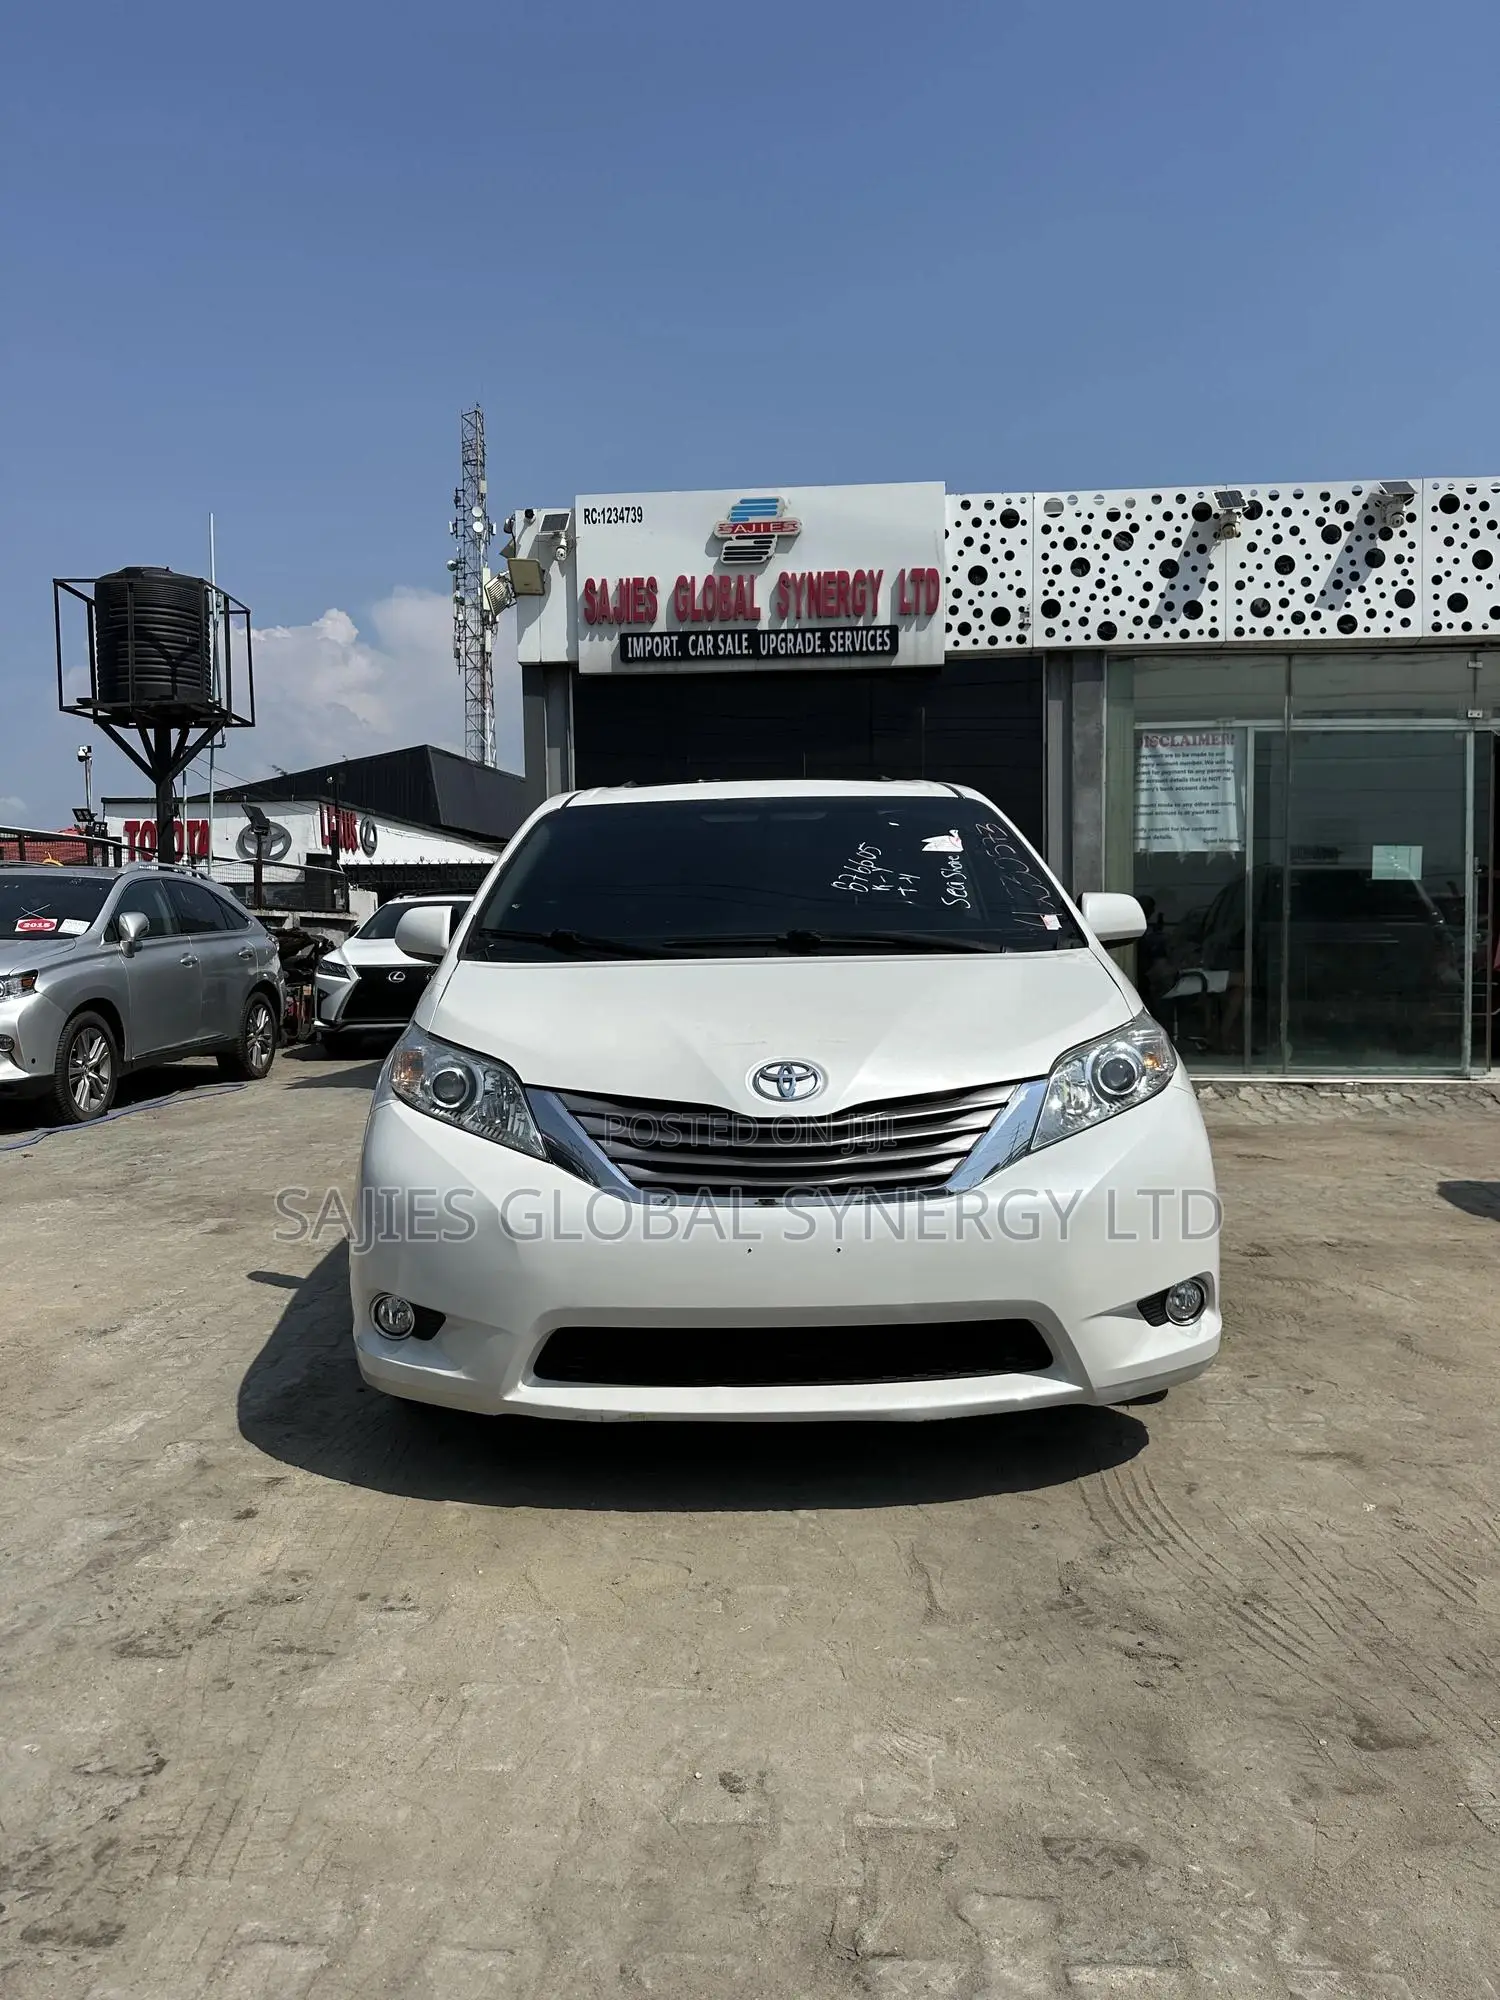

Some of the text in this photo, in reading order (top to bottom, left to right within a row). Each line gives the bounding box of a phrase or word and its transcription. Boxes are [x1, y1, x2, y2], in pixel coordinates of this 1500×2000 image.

[584, 506, 643, 525] RC:1234739
[719, 520, 798, 534] SAJIES
[583, 567, 941, 626] SAJIES GLOBAL SYNERGY LTD
[627, 628, 891, 659] IMPORT. CAR SALE. UPGRADE. SERVICES
[124, 820, 212, 862] TOOTA
